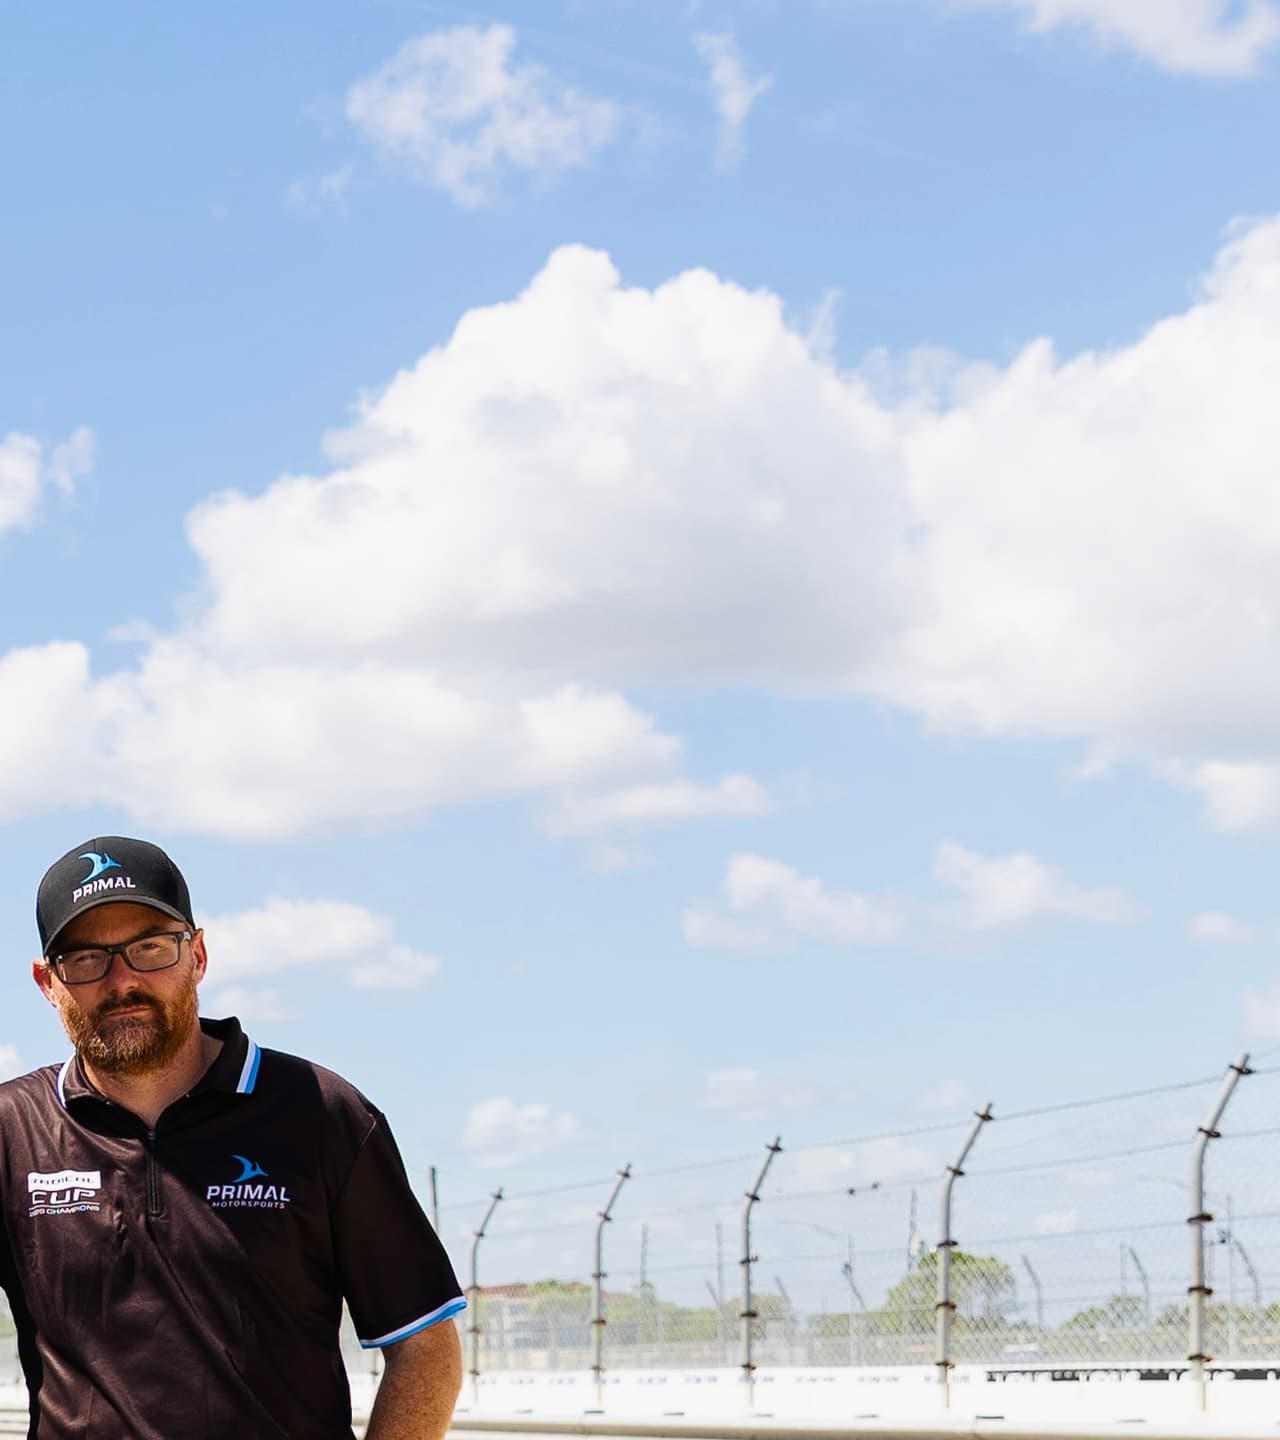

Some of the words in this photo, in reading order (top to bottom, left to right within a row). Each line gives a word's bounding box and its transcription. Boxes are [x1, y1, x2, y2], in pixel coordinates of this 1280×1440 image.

[72, 876, 137, 903] PRIMAL
[32, 1188, 96, 1205] CUP
[206, 1184, 290, 1202] PRIMAL
[212, 1200, 285, 1209] MOTORSPORTS
